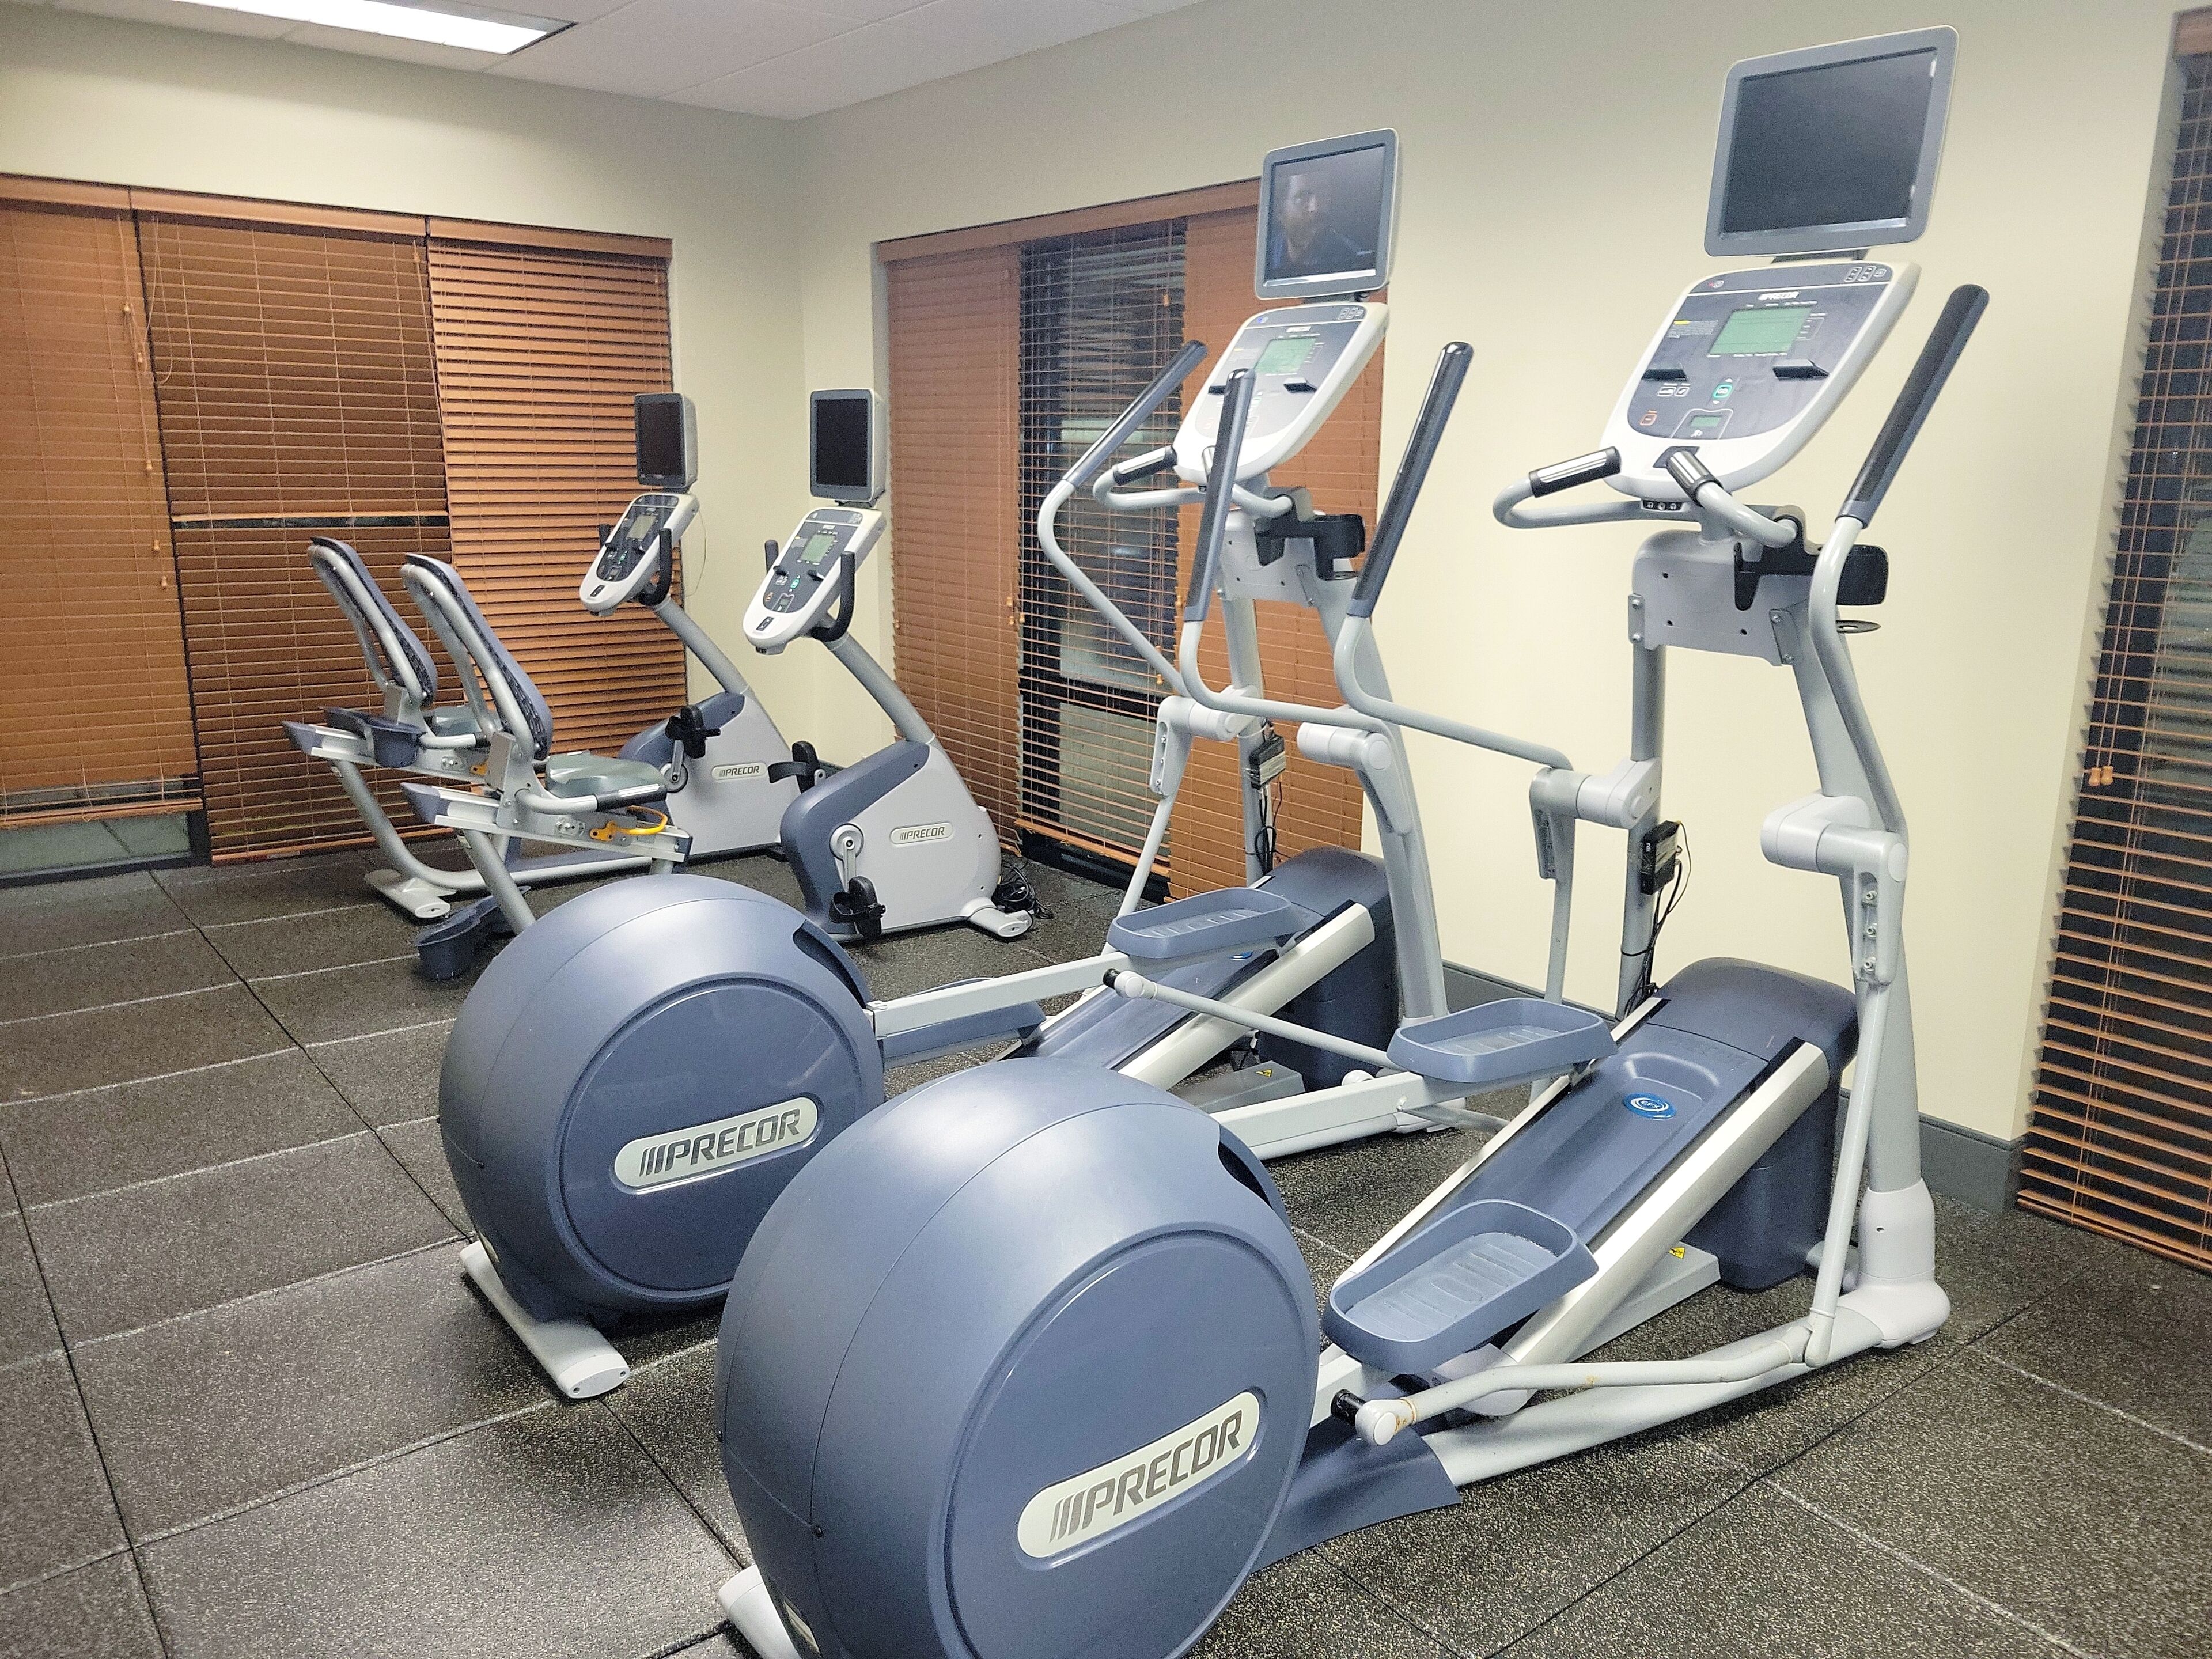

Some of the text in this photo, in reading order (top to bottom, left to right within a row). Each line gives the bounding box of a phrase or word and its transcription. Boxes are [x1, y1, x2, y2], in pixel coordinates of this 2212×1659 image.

[725, 766, 760, 777] PRECOR
[906, 826, 945, 840] PRECOR
[664, 1108, 800, 1172] PRECOR
[1082, 1410, 1242, 1529] PRECOR
